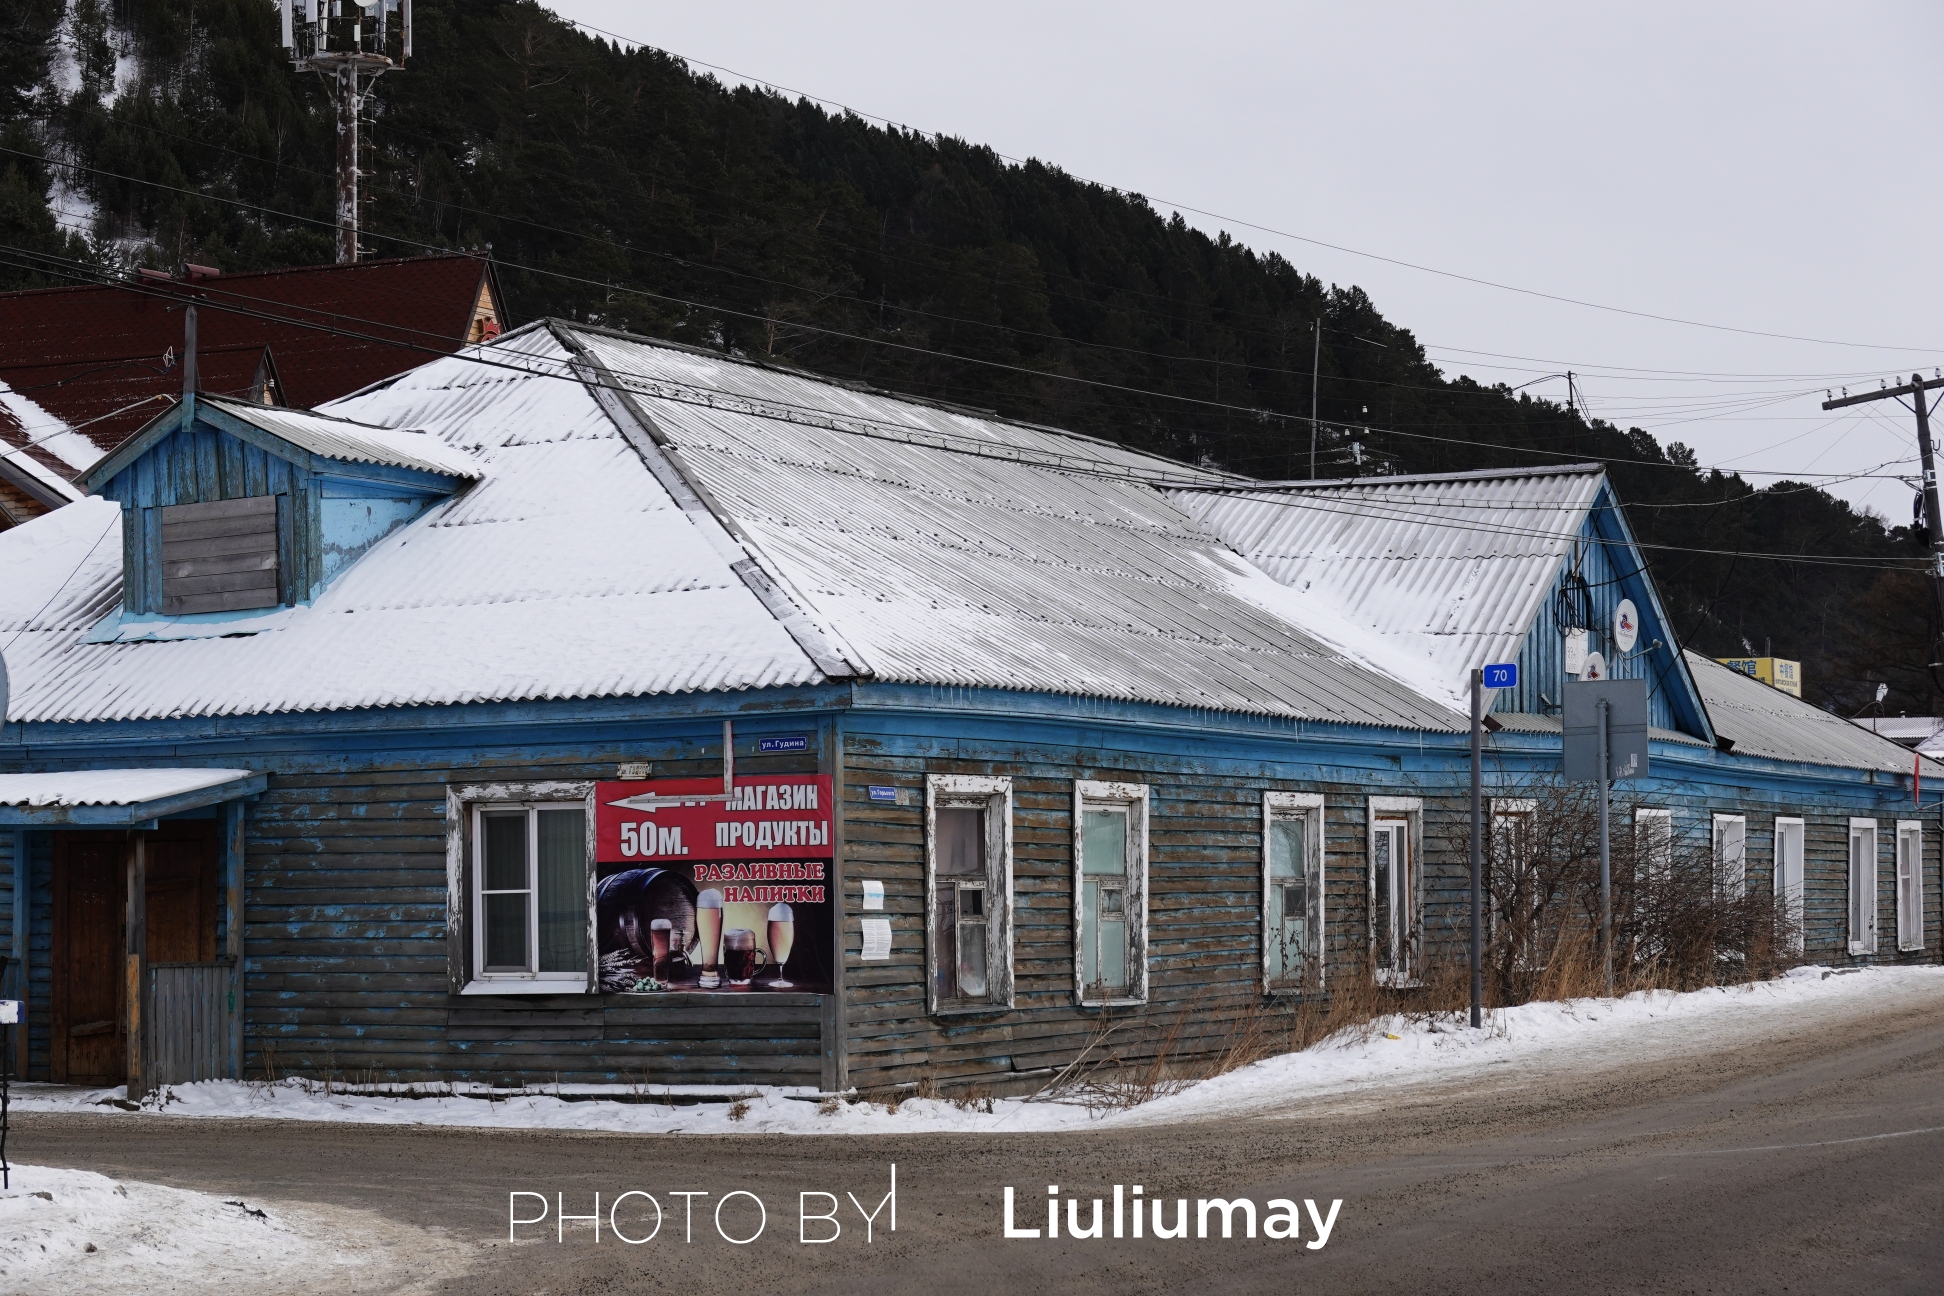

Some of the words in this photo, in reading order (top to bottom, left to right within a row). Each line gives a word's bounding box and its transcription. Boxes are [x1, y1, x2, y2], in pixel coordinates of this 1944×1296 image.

[1493, 669, 1508, 682] 70
[725, 785, 818, 811] МАГАЗИН
[715, 820, 828, 850] ПРОДУКТЫ
[694, 863, 825, 881] РАЗЛИВНЫЕ
[723, 885, 825, 903] НАПИТКИ
